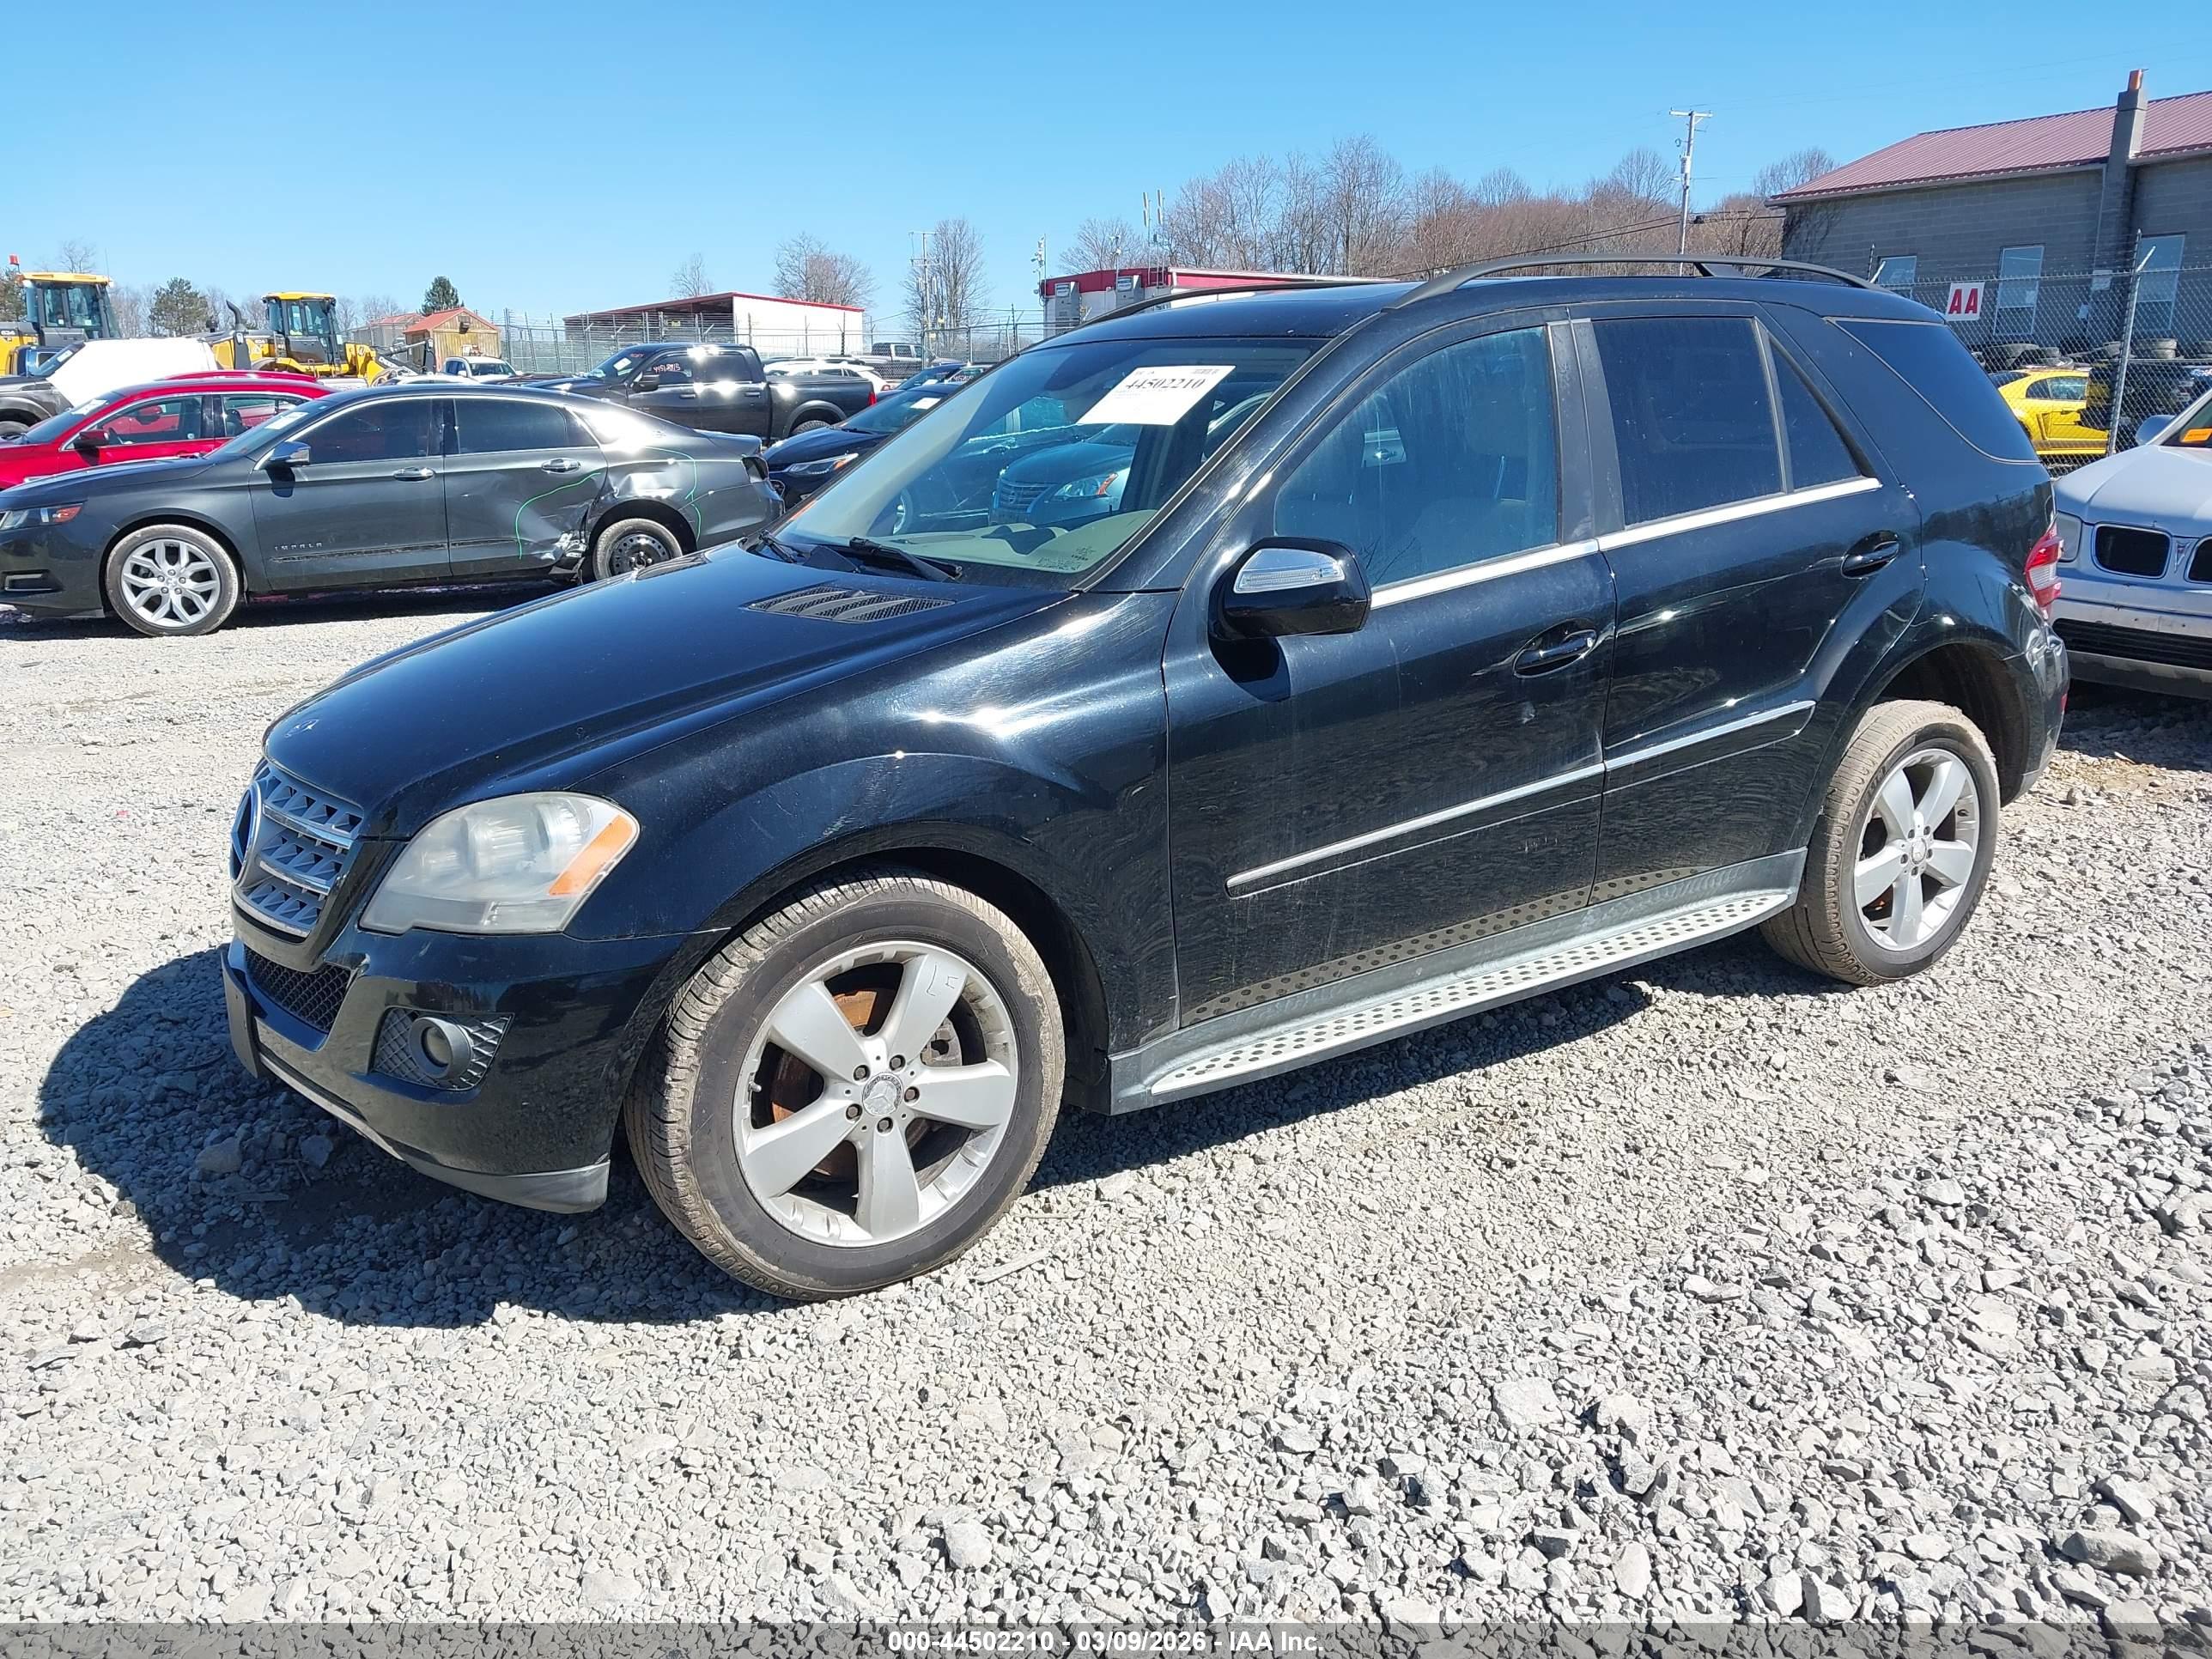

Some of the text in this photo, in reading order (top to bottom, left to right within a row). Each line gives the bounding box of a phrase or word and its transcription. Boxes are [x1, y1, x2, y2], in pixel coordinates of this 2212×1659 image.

[1948, 288, 1978, 314] AA
[1126, 378, 1206, 389] 44502210
[274, 542, 323, 551] IMPALA
